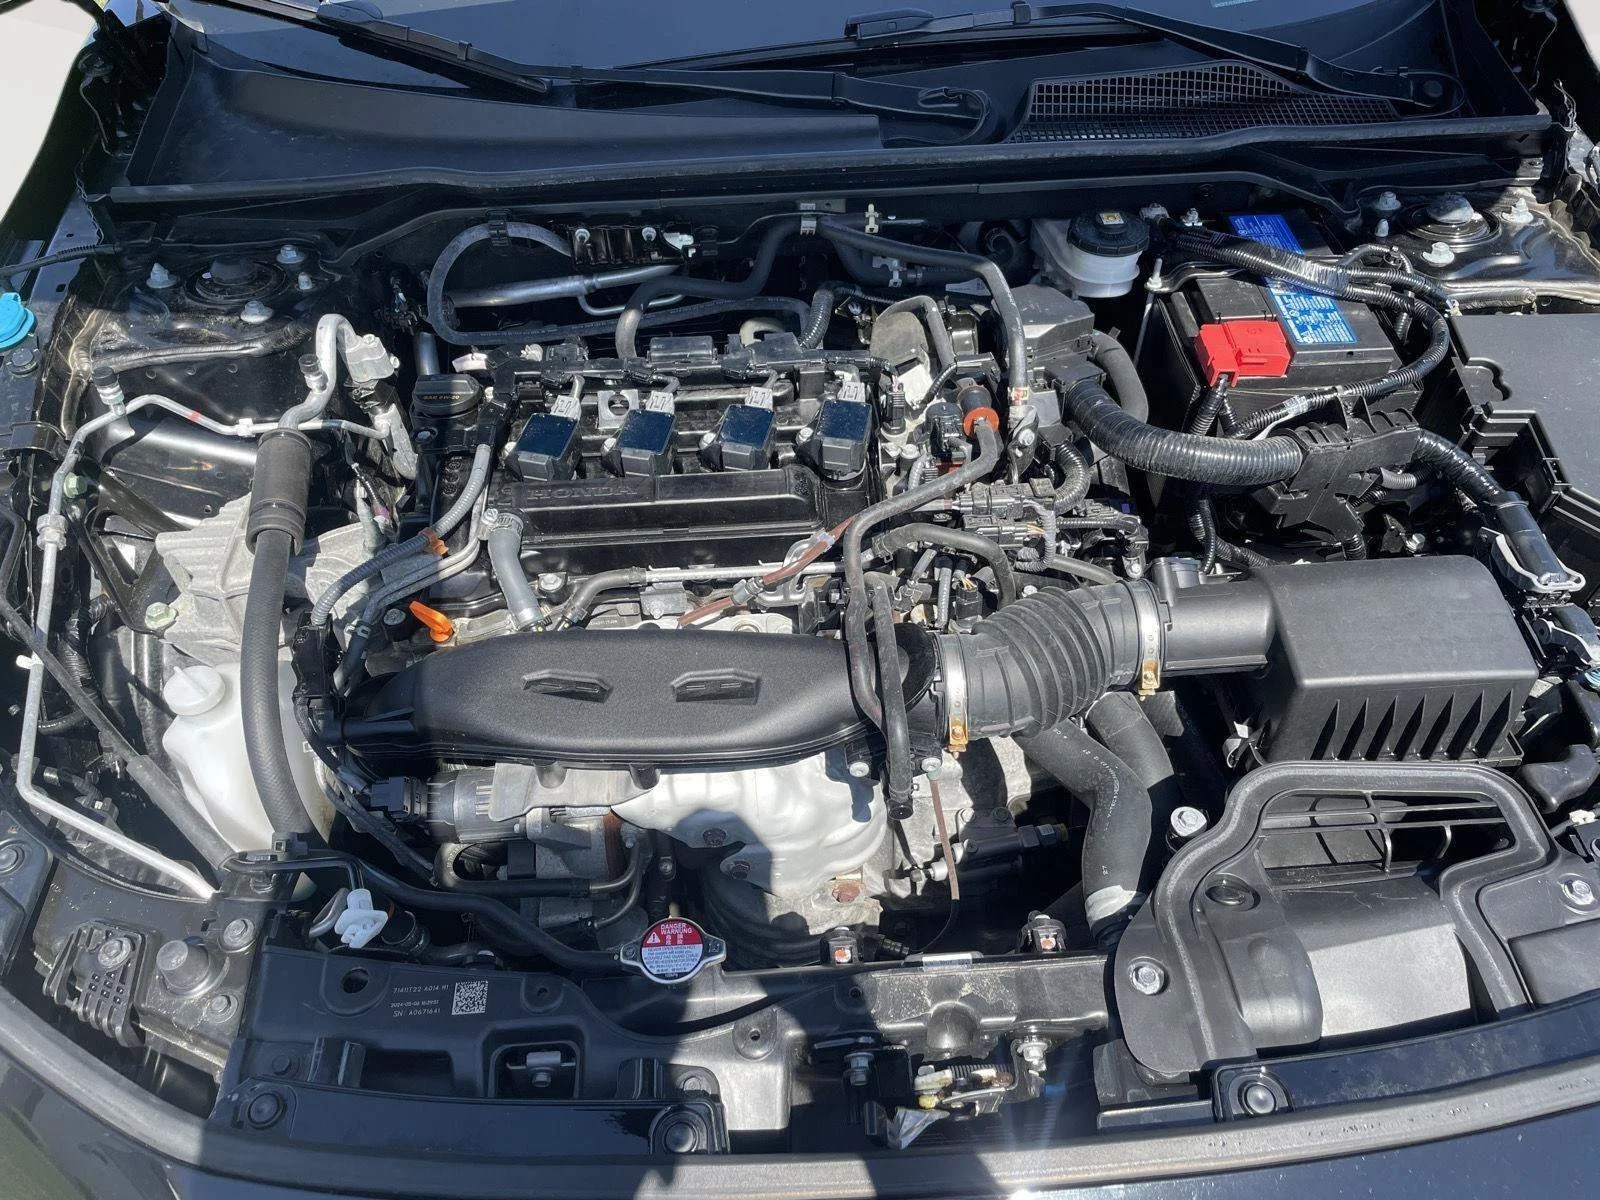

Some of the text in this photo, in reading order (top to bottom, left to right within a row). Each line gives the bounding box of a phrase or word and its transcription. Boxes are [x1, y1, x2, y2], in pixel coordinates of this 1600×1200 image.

[527, 485, 638, 500] HONDA
[660, 922, 687, 930] DANGER
[660, 927, 693, 935] WARNUNG
